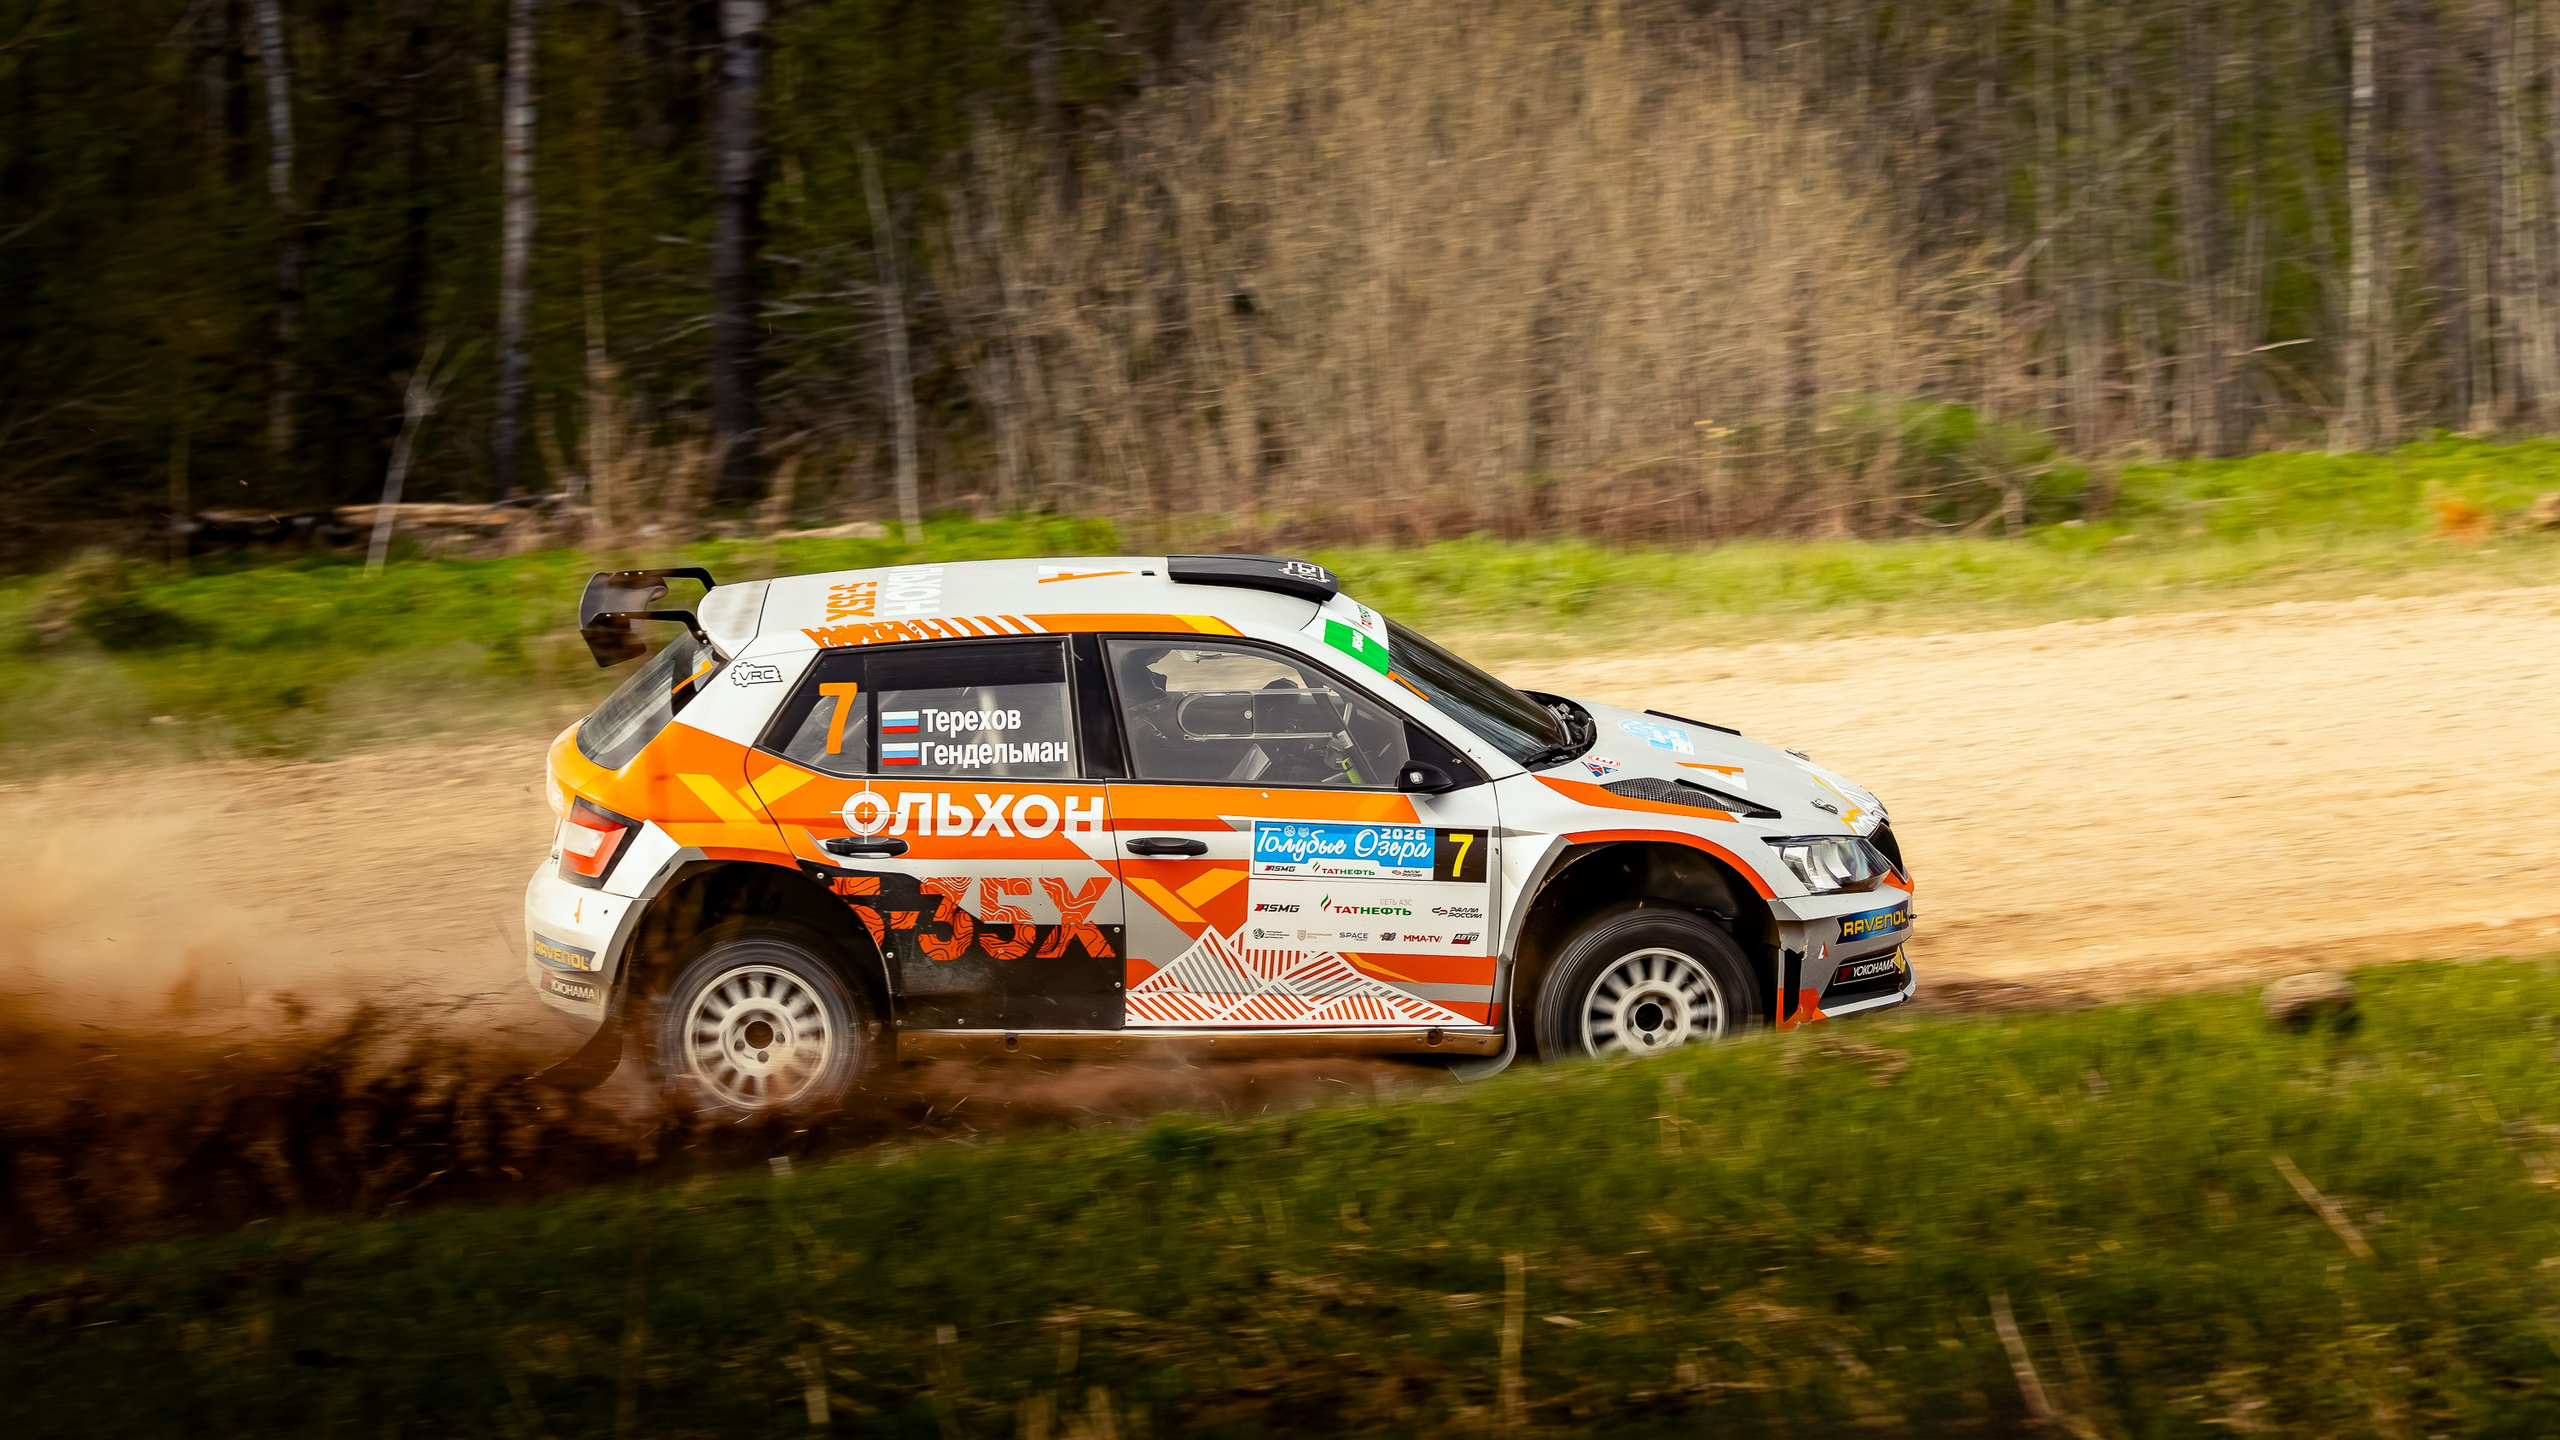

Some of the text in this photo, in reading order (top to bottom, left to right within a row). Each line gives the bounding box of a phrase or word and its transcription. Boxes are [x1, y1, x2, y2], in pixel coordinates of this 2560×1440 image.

[739, 670, 774, 681] VRC
[818, 682, 858, 755] 7
[921, 708, 1022, 739] Терехов
[920, 741, 1069, 769] Гендельман
[842, 790, 1105, 839] ОЛЬХОН
[1380, 828, 1426, 841] 2026
[1354, 829, 1432, 866] Озера
[1448, 833, 1474, 878] 7
[1265, 865, 1296, 873] ASMG
[1321, 868, 1376, 876] ТАТНЕФТЬ
[1254, 903, 1300, 913] ASMG
[1333, 905, 1413, 916] ТАТНЕФТЬ
[1380, 898, 1413, 907] СЕТЬ АЗС
[1843, 909, 1906, 937] RAVENOL
[534, 939, 589, 971] RAVENOL
[1853, 958, 1894, 978] YOKOHAMA
